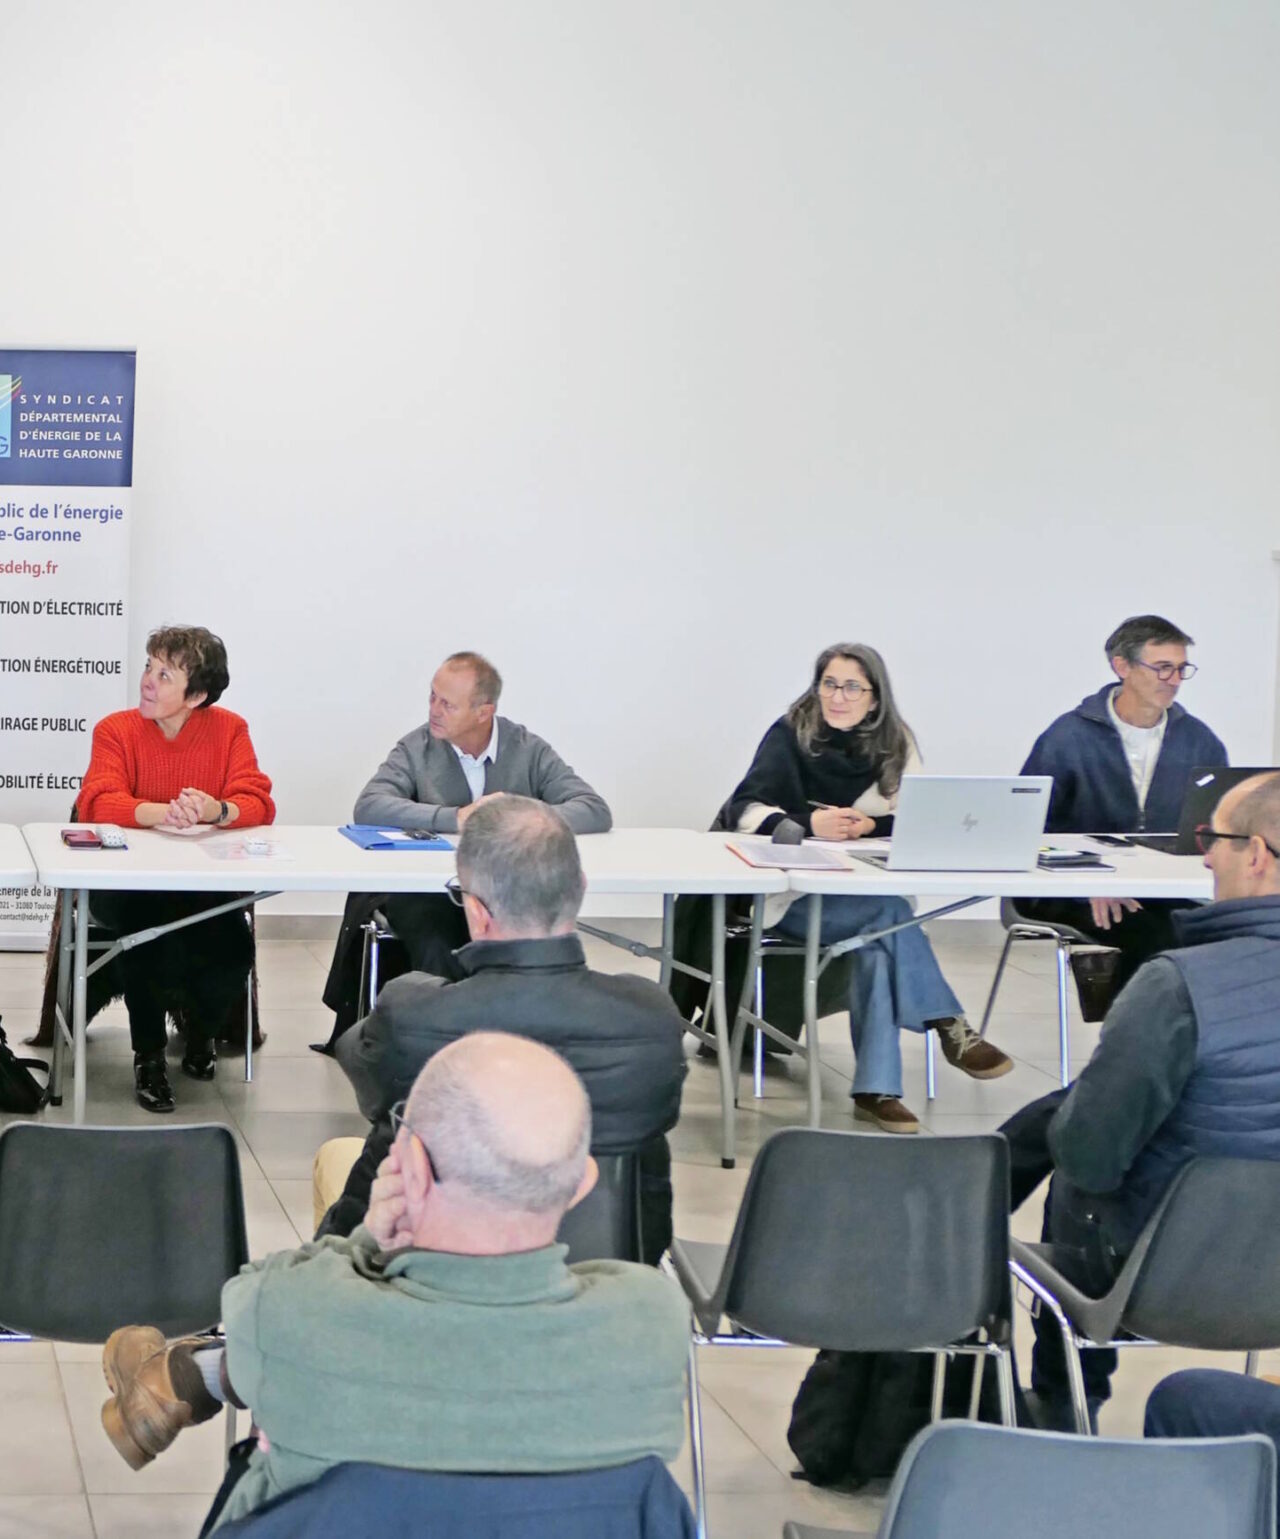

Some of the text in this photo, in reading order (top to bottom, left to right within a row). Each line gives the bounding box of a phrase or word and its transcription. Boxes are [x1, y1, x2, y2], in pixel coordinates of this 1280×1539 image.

[19, 395, 124, 405] SYNDICAT
[19, 411, 123, 424] DÉPARTEMENTAL
[19, 428, 122, 442] D'ÉNERGIE DE LA
[19, 448, 123, 460] HAUTE GARONNE
[28, 503, 49, 519] de
[54, 503, 124, 524] l'énergie
[32, 599, 123, 616] D'ÉLECTRICITÉ
[34, 656, 122, 675] ÉNERGÉTIQUE
[41, 717, 87, 732] PUBLIC
[46, 773, 84, 790] ÉLECT
[31, 885, 42, 897] de
[43, 885, 52, 897] la
